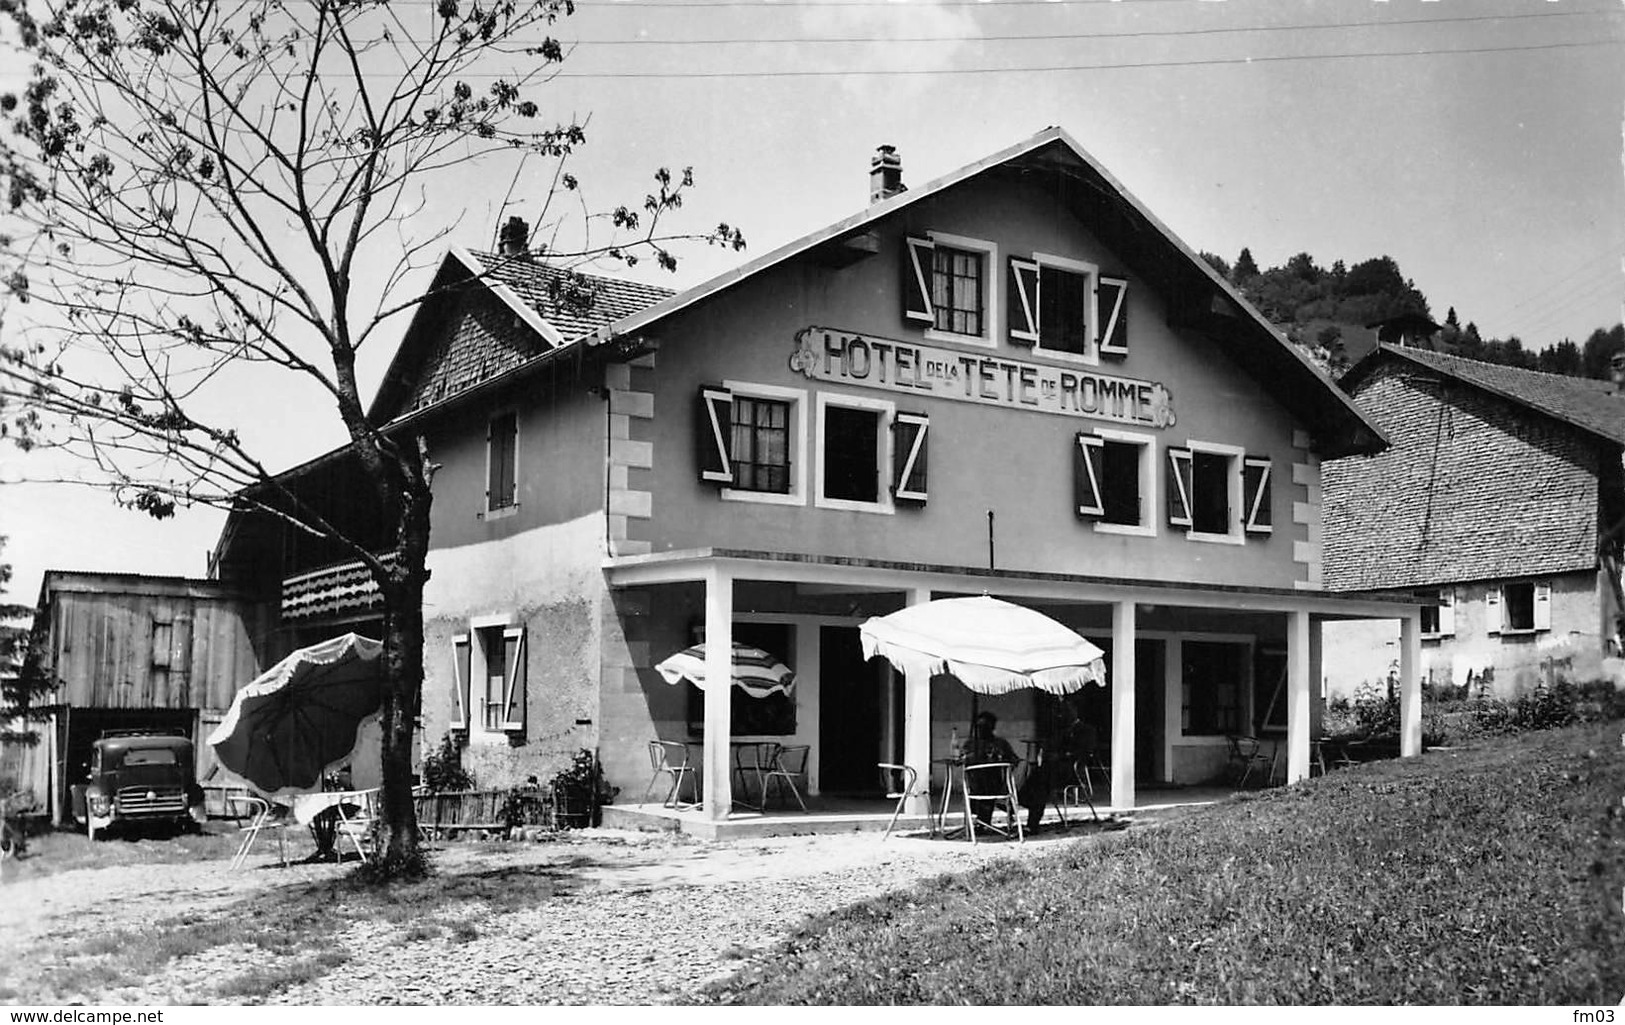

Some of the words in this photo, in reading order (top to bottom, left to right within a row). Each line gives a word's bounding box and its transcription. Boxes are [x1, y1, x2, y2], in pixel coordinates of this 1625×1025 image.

[824, 333, 932, 390] HÔTEL
[926, 360, 943, 378] DE
[945, 362, 960, 381] LA
[958, 356, 1038, 406] TÊTE
[1041, 379, 1056, 397] DE
[1061, 373, 1153, 422] ROMME
